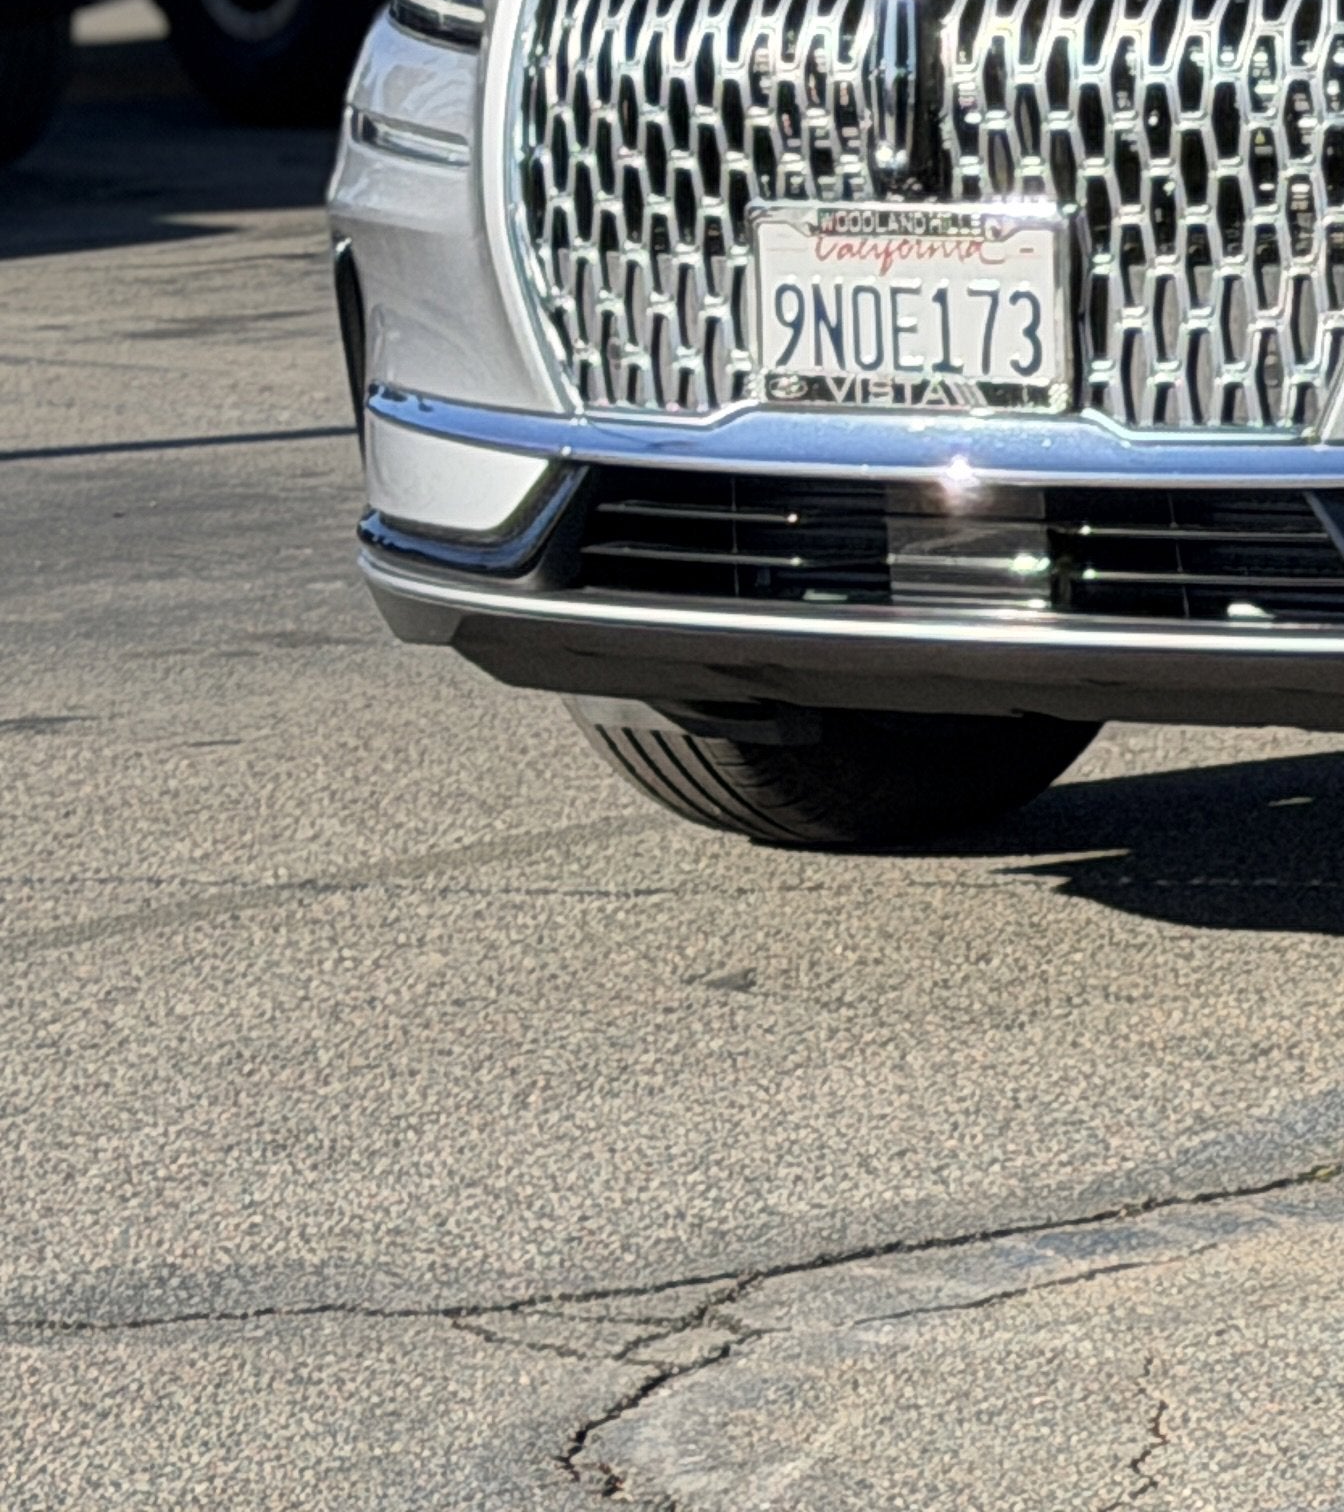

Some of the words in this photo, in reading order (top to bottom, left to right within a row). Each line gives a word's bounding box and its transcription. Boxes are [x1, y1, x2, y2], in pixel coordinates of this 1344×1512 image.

[819, 209, 926, 234] WOODLAND
[814, 236, 1006, 277] California
[774, 278, 1045, 377] 9NOE173
[824, 373, 952, 407] VISTA
